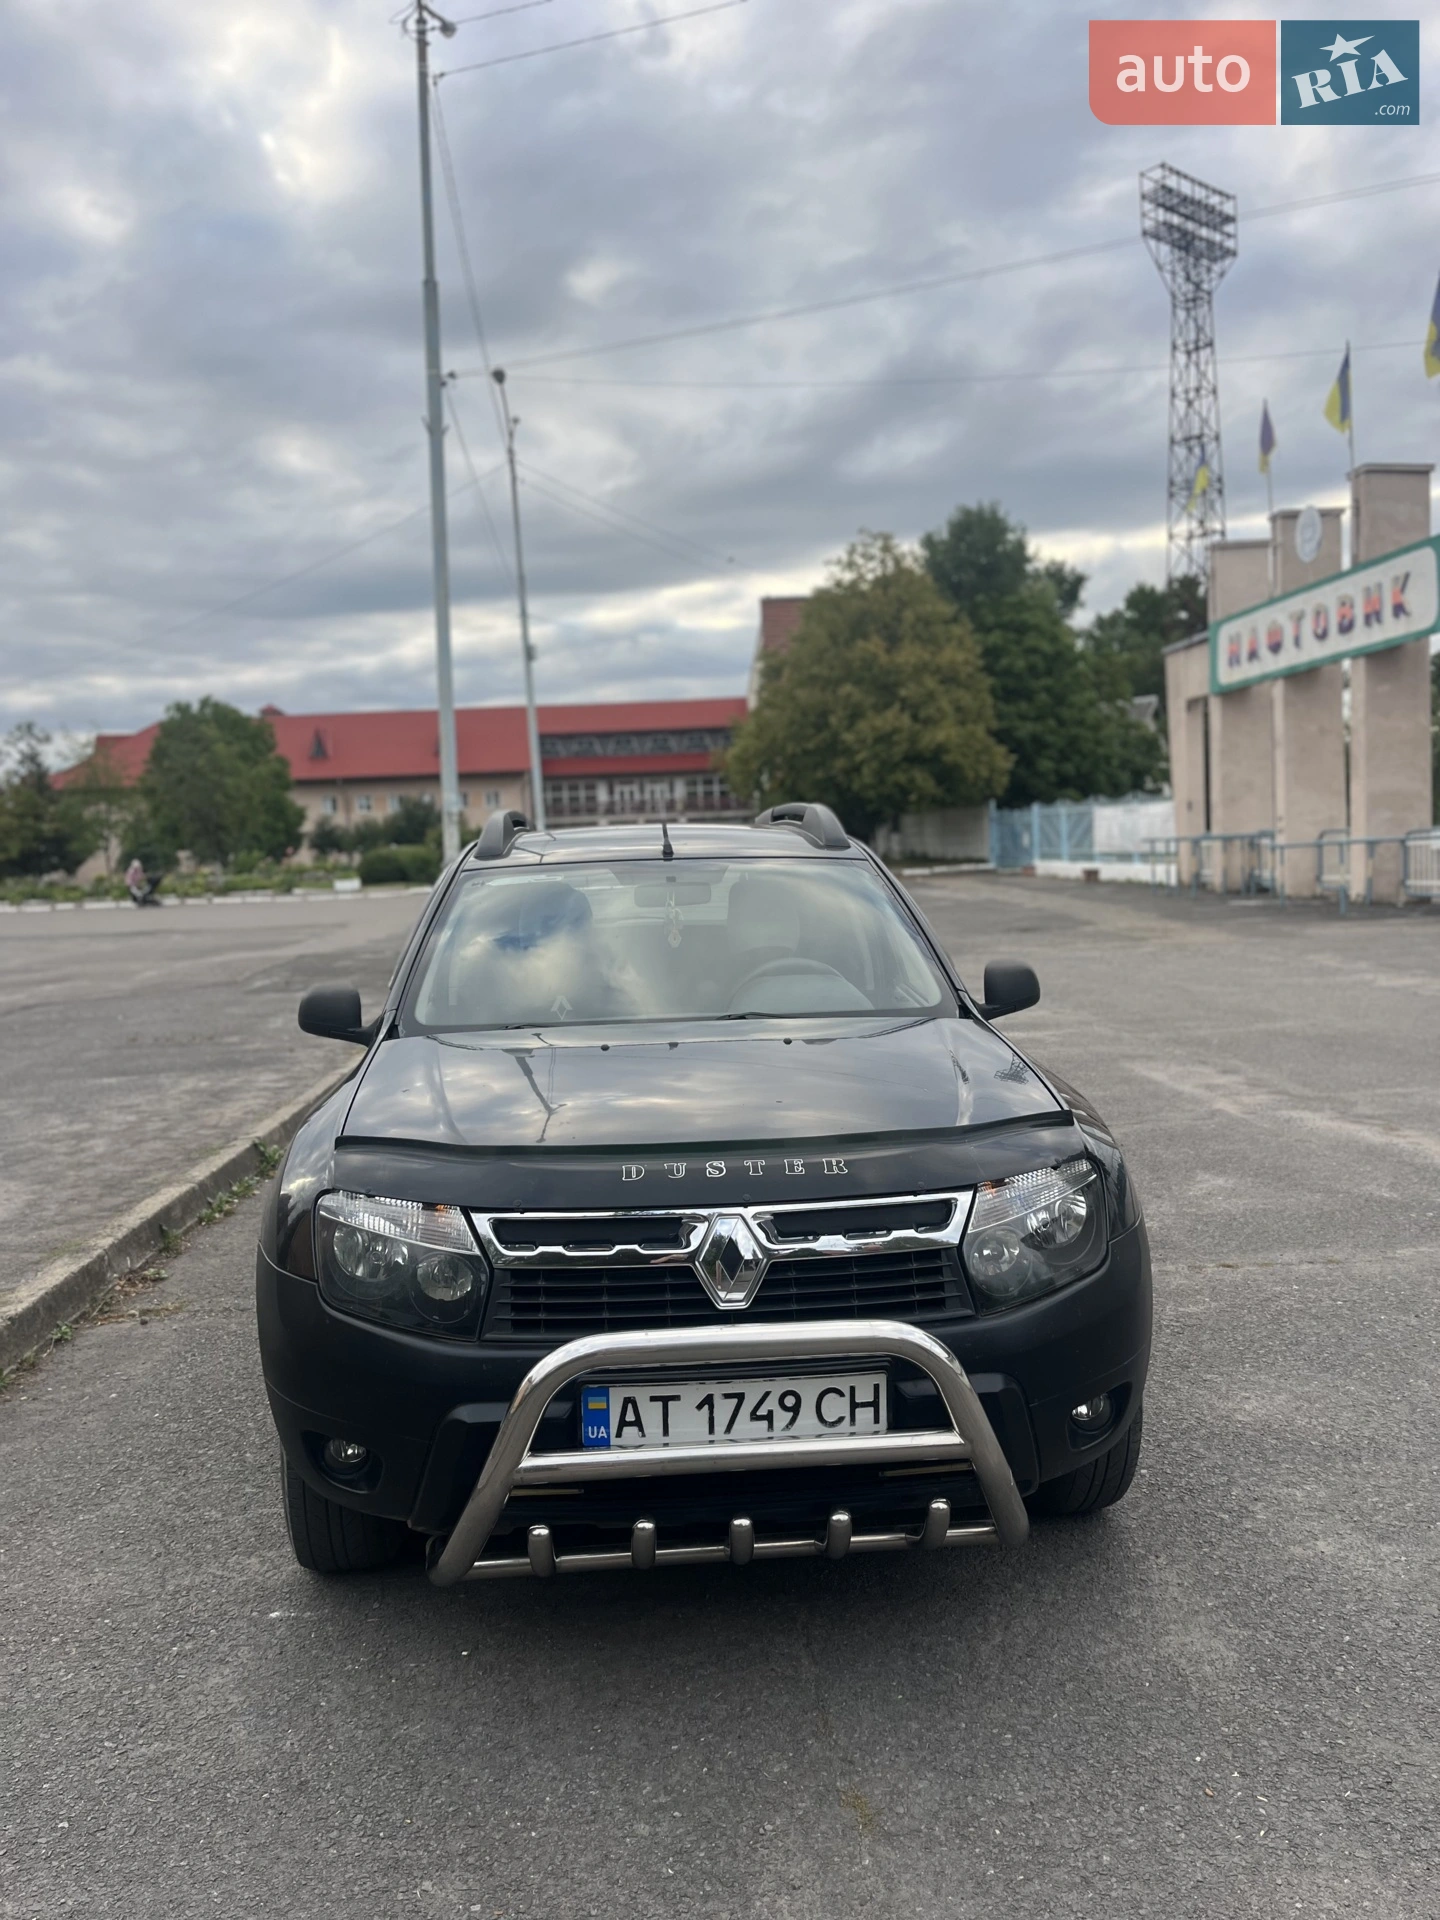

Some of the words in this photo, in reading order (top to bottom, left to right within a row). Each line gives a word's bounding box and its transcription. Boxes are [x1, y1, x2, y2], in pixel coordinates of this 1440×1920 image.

[622, 1158, 848, 1181] DUSTER
[615, 1395, 681, 1438] AT
[695, 1390, 802, 1435] 1749
[815, 1383, 880, 1428] CH
[588, 1426, 607, 1439] UA
